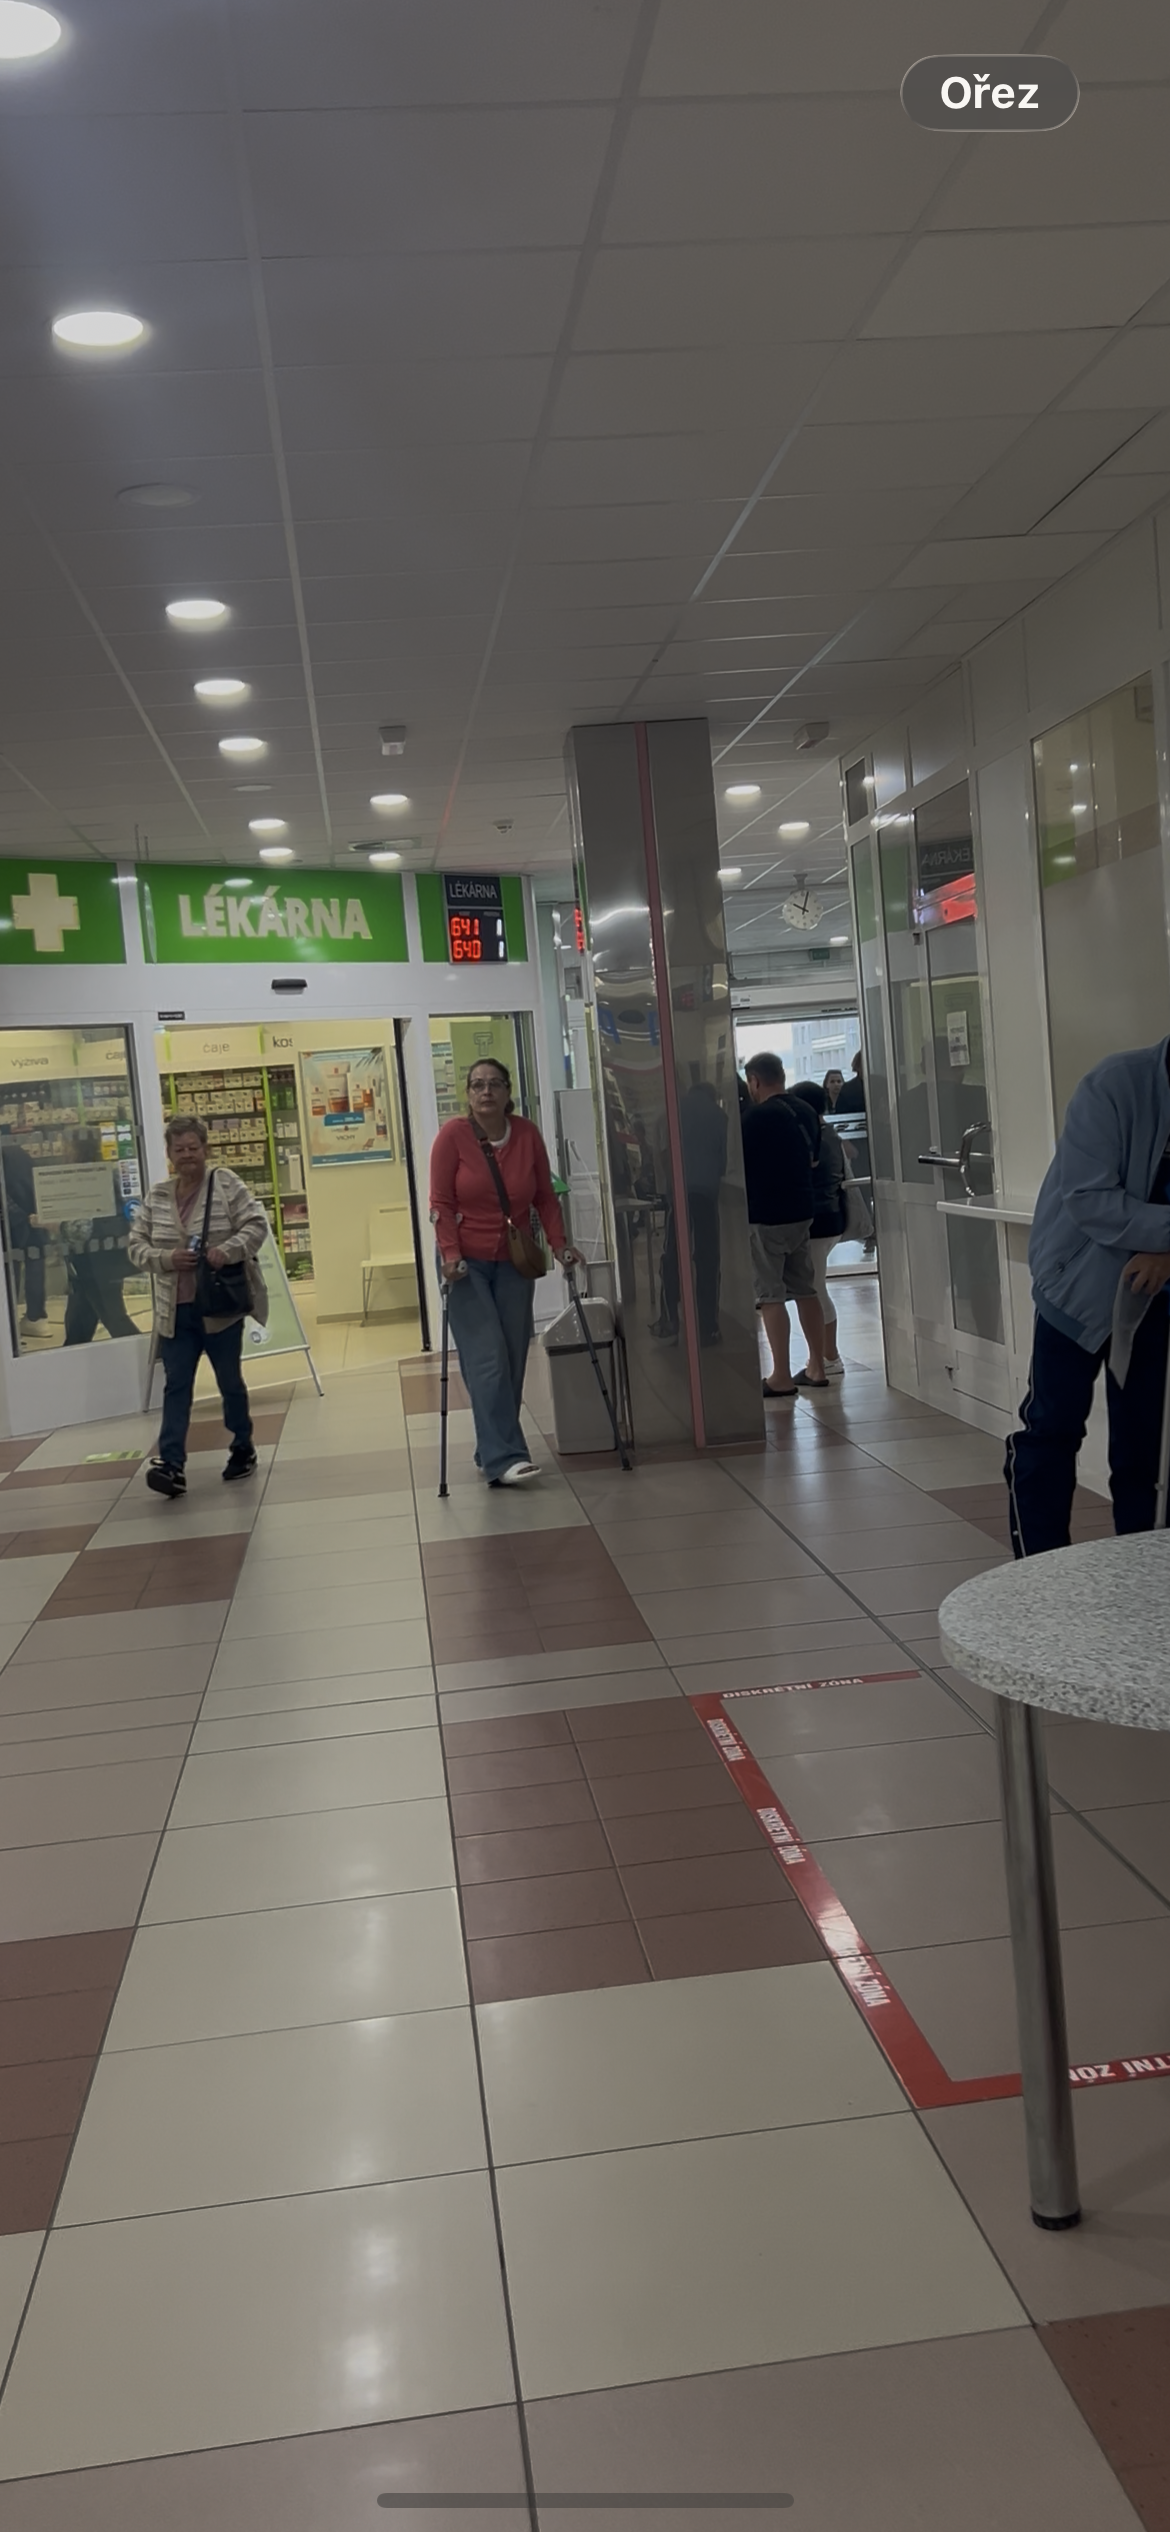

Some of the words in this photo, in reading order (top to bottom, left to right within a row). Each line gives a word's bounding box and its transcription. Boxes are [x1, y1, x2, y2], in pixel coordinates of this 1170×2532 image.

[449, 880, 498, 898] LÉKÁRNA
[178, 884, 373, 939] LÉKÁRNA
[451, 917, 479, 936] 641
[453, 939, 481, 958] 640
[105, 1050, 126, 1062] čaj
[722, 1683, 812, 1698] DISKRÉTNÍ
[818, 1677, 863, 1687] ZÓNA
[853, 1978, 891, 2007] ZÓNA
